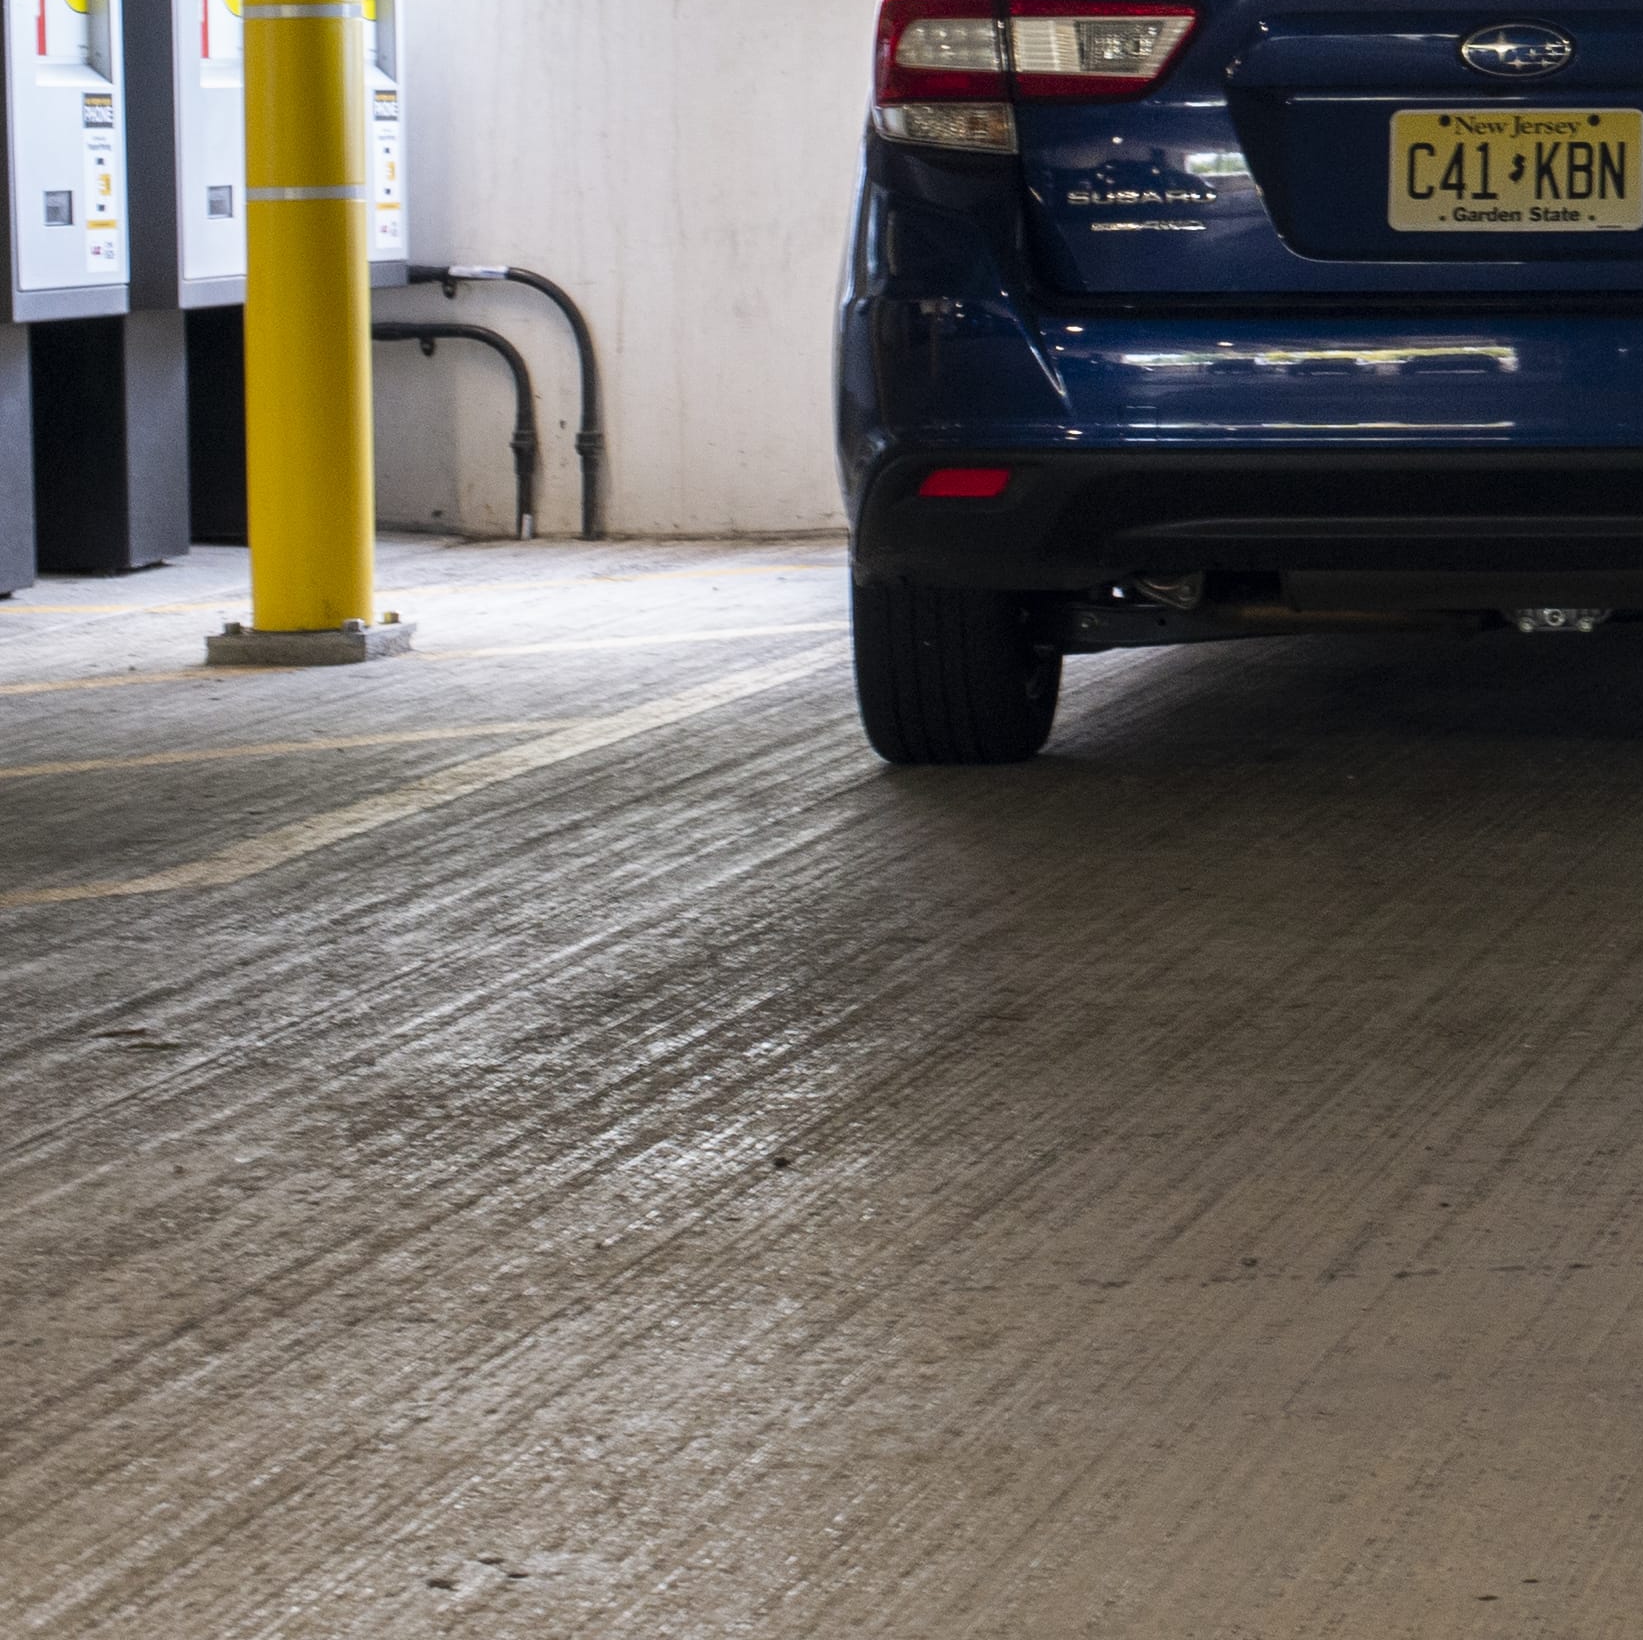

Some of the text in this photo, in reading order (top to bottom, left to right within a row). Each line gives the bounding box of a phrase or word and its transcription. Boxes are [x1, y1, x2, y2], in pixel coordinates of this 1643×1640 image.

[1454, 115, 1581, 138] New Jersey
[1407, 141, 1626, 200] C41 KBN
[1452, 206, 1580, 223] Garden State
